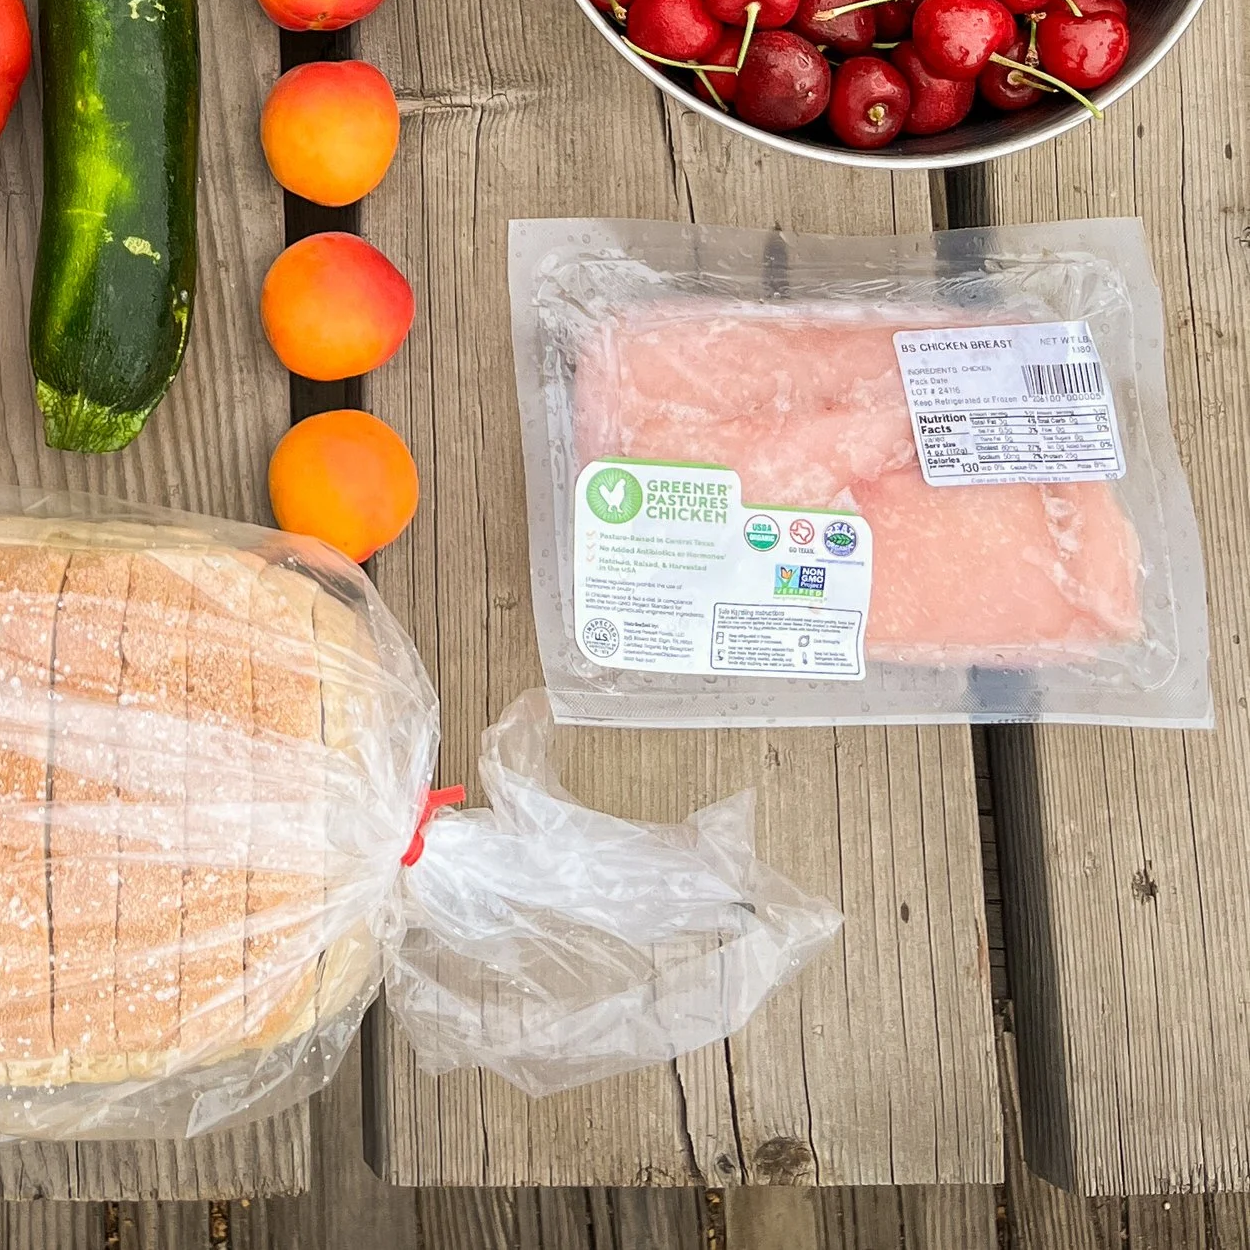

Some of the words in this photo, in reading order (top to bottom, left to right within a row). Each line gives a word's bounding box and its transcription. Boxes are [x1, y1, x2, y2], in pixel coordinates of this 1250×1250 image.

[1039, 337, 1058, 345] NET
[1060, 336, 1075, 344] WT
[901, 343, 917, 353] BS
[919, 341, 968, 352] CHICKEN
[969, 339, 1013, 350] BREAST
[961, 365, 992, 373] CHICKEN
[909, 378, 929, 386] Pack
[911, 388, 928, 396] LOT
[913, 399, 933, 407] Keep
[934, 396, 981, 406] Refrigerated
[991, 395, 1018, 404] Frozen
[918, 413, 967, 424] Nutrition
[921, 424, 953, 434] Facts
[927, 457, 961, 465] Calories
[960, 462, 980, 473] 130
[646, 480, 728, 497] GREENER
[646, 493, 729, 510] PASTURES
[646, 506, 727, 524] CHICKEN
[752, 523, 772, 532] USDA
[749, 533, 775, 542] ORGANIC
[610, 546, 635, 554] Added
[636, 548, 676, 557] Antibiotics
[802, 567, 824, 576] NON
[801, 575, 824, 583] GMO
[800, 581, 823, 589] Project
